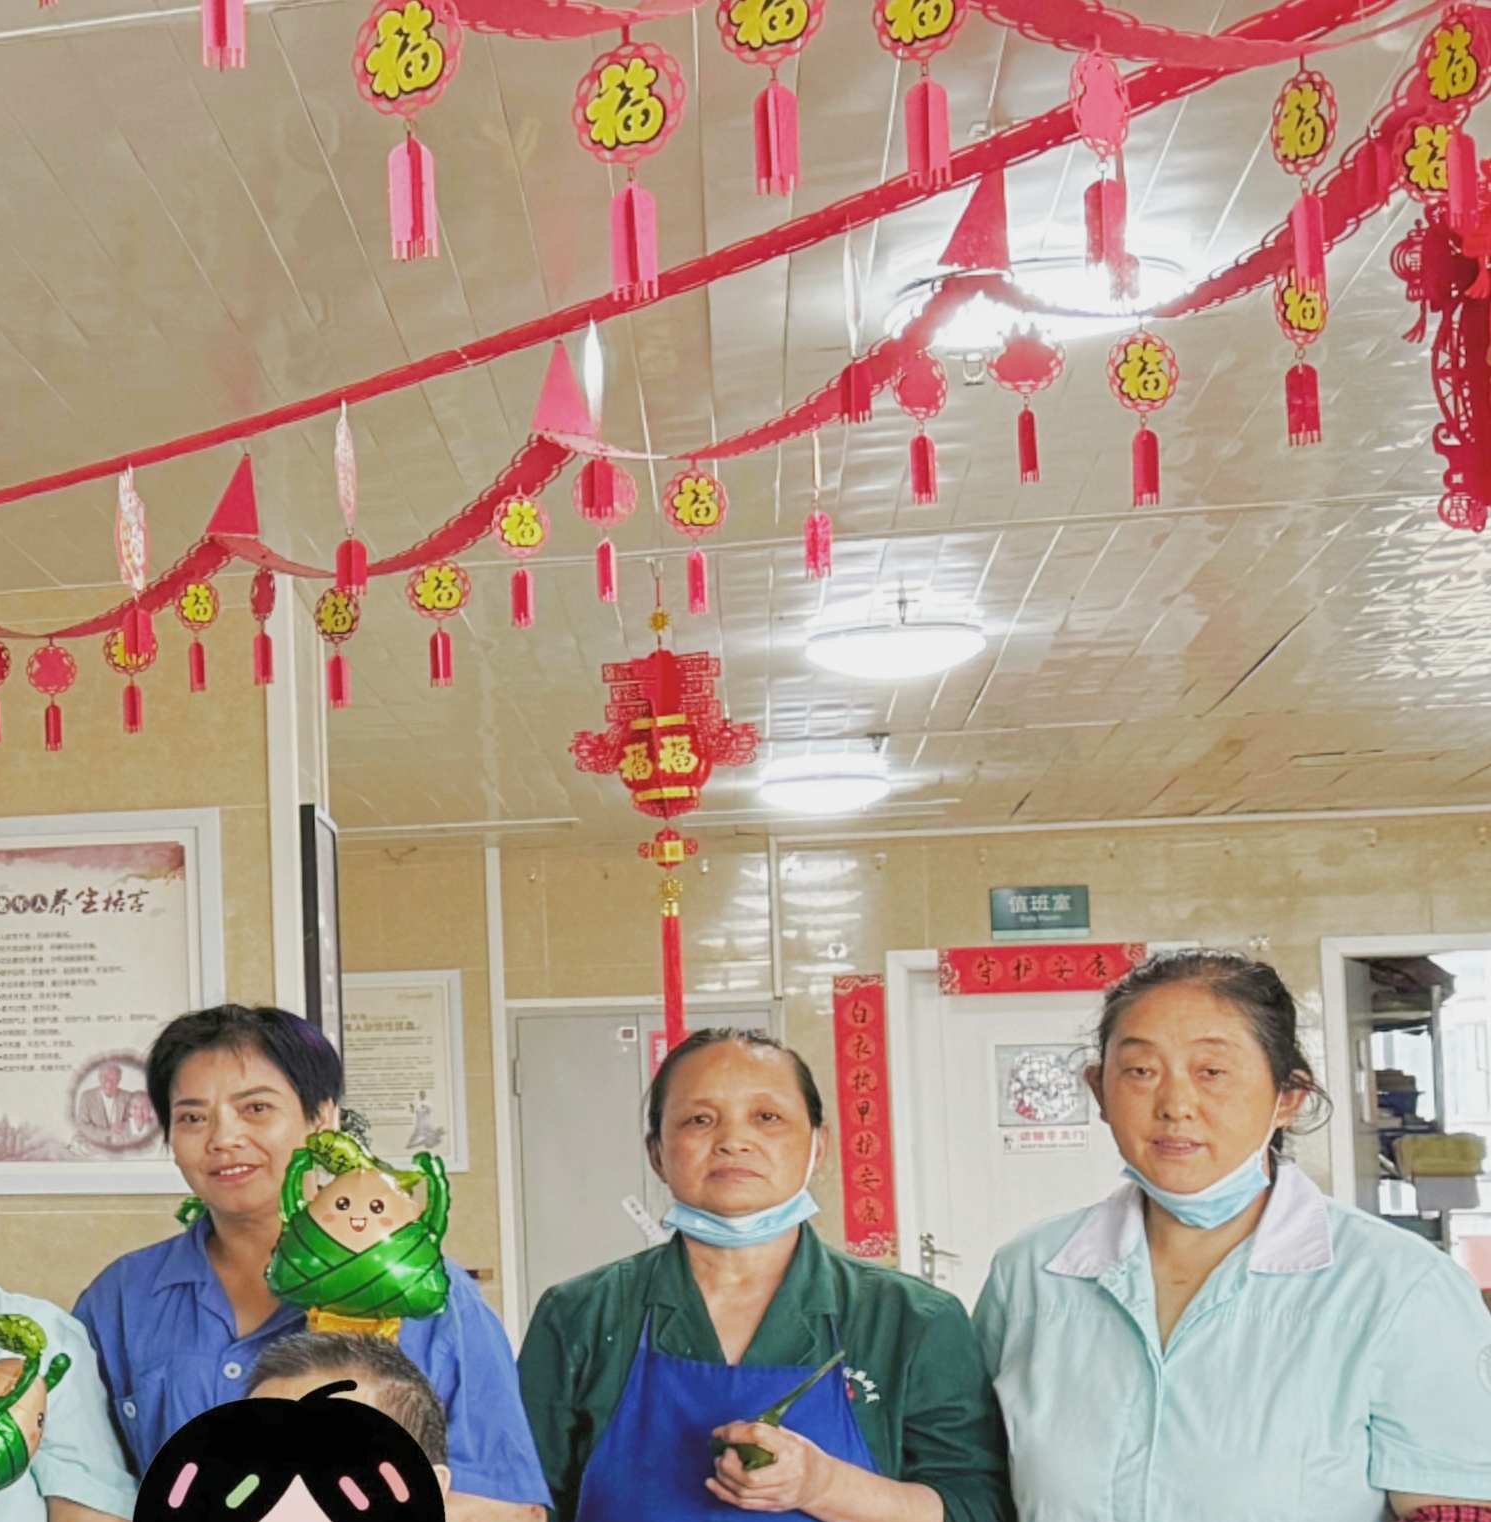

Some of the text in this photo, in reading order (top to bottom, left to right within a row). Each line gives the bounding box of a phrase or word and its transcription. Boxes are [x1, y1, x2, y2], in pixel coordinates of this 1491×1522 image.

[365, 0, 446, 100] 福
[1426, 23, 1479, 101] 福
[585, 57, 666, 150] 福
[1279, 82, 1329, 162] 福
[1117, 341, 1172, 401] 福
[500, 499, 545, 547] 福
[674, 475, 720, 527] 福
[181, 582, 216, 625] 福
[415, 565, 463, 611] 福
[620, 740, 654, 782] 福
[659, 735, 700, 775] 福
[1008, 894, 1073, 914] 值班室
[977, 955, 1109, 986] 守护安康
[851, 1001, 881, 1224] 白衣执甲护安康
